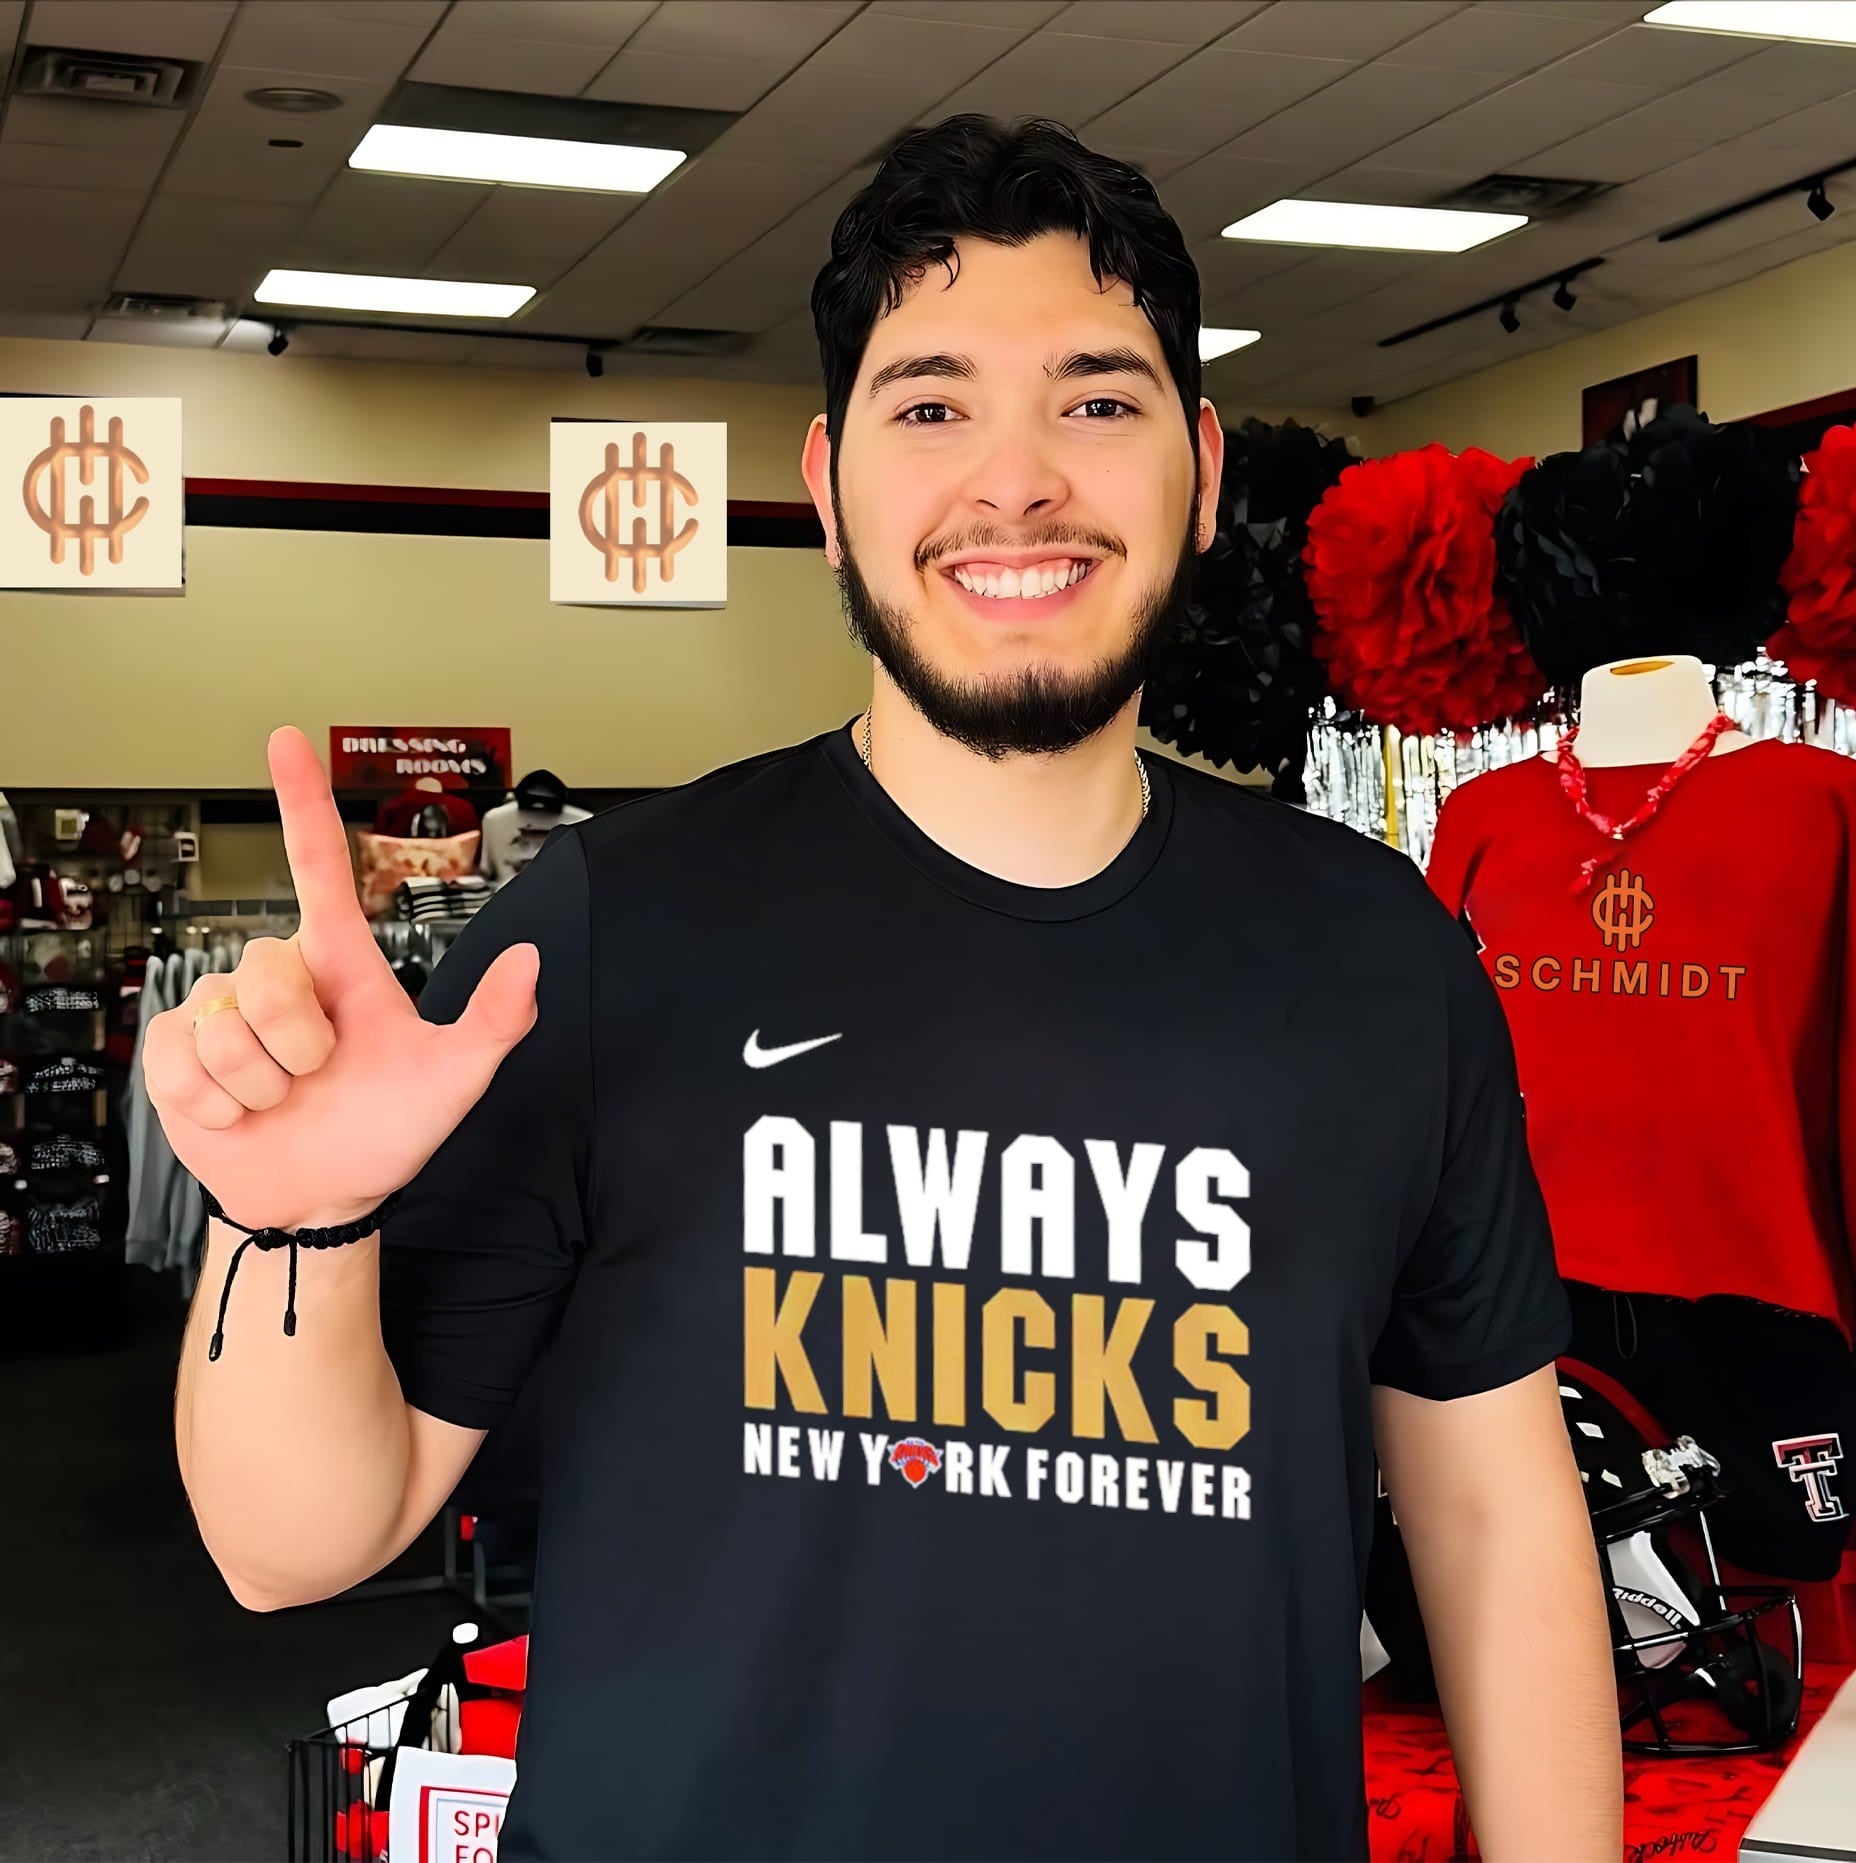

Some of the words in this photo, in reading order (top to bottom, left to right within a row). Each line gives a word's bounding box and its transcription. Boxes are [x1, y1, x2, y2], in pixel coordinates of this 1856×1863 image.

[342, 737, 467, 753] DRESSING
[396, 758, 487, 775] ROOMS
[1494, 954, 1746, 1000] SCHMIDT
[743, 1115, 1251, 1291] ALWAYS
[743, 1266, 1251, 1450] KNICKS
[743, 1422, 845, 1481] NEW
[1026, 1447, 1251, 1520] FOREVER
